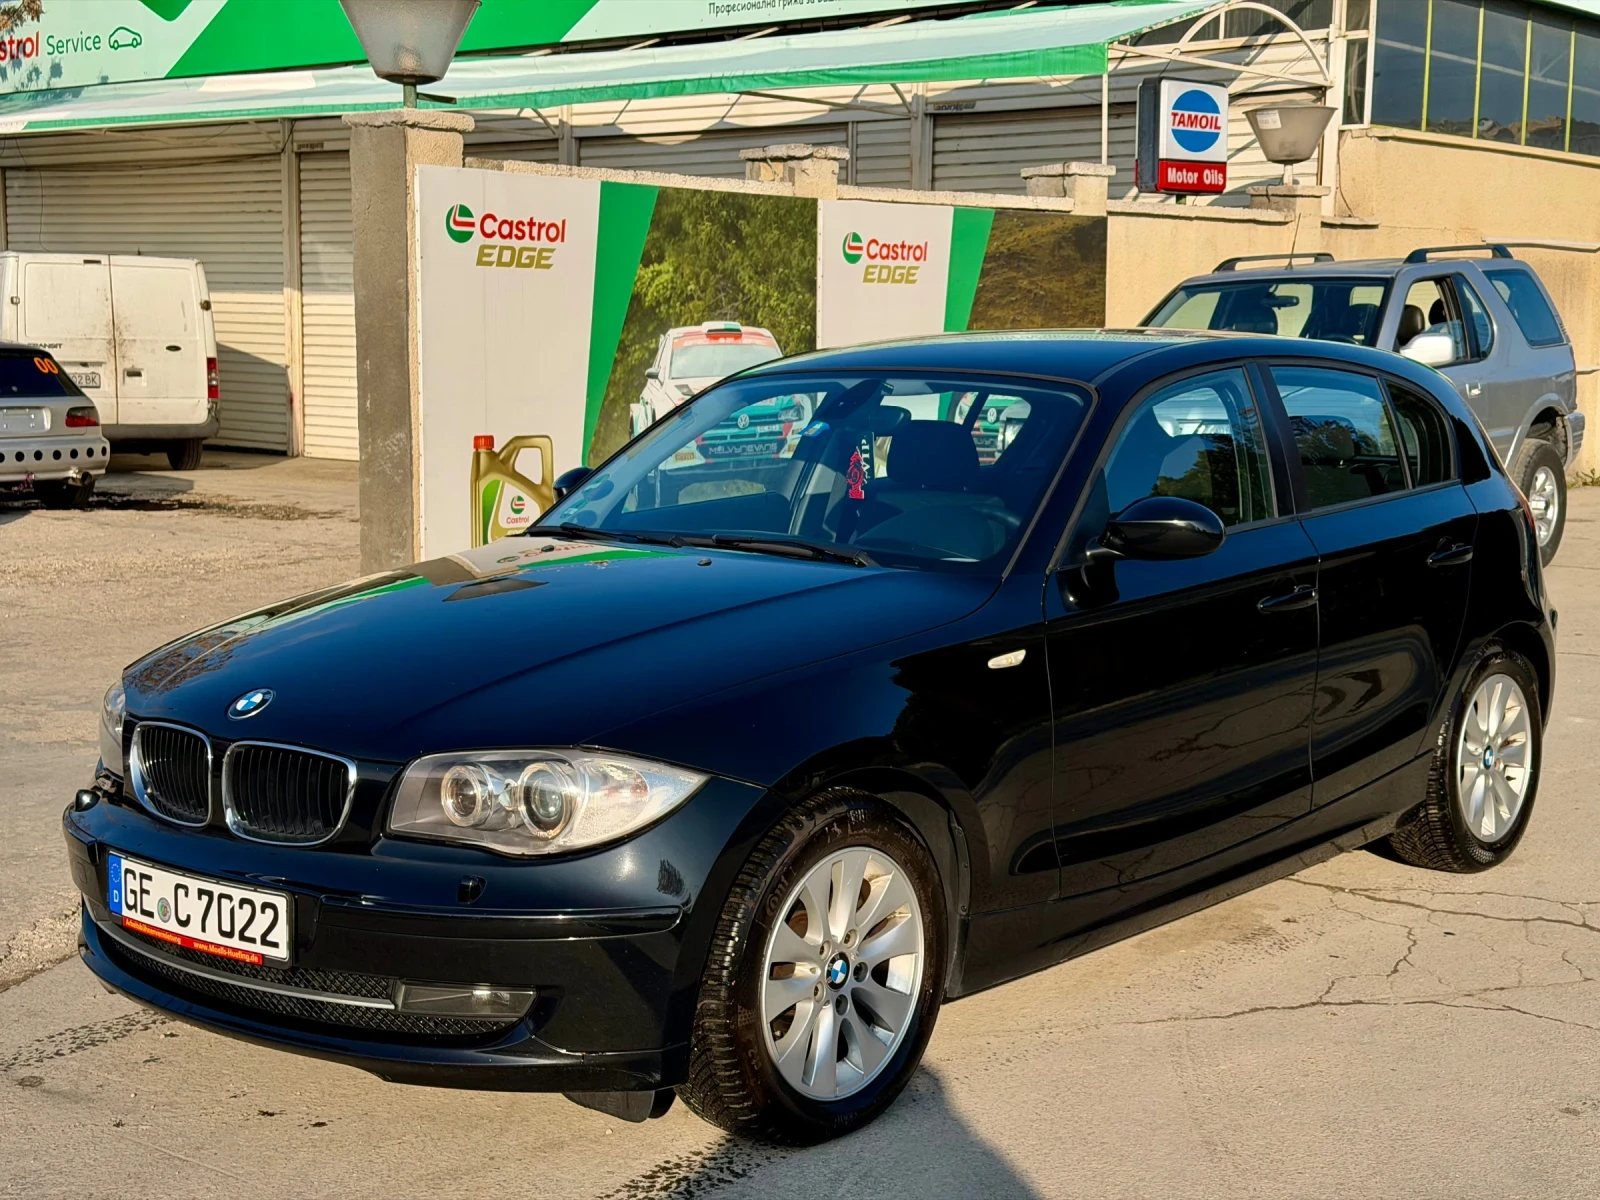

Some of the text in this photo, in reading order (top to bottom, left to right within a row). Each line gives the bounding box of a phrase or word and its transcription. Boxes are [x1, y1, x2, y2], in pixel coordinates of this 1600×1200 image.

[709, 1, 776, 17] Професионална
[46, 31, 101, 55] Service
[1171, 111, 1222, 131] TAMOIL
[1167, 167, 1224, 185] Motor Oils
[479, 213, 566, 243] Castrol
[475, 243, 557, 270] EDGE
[866, 238, 928, 262] Castrol
[862, 264, 921, 284] EDGE
[506, 516, 530, 524] Castrol
[113, 889, 119, 902] D
[123, 867, 154, 919] GE
